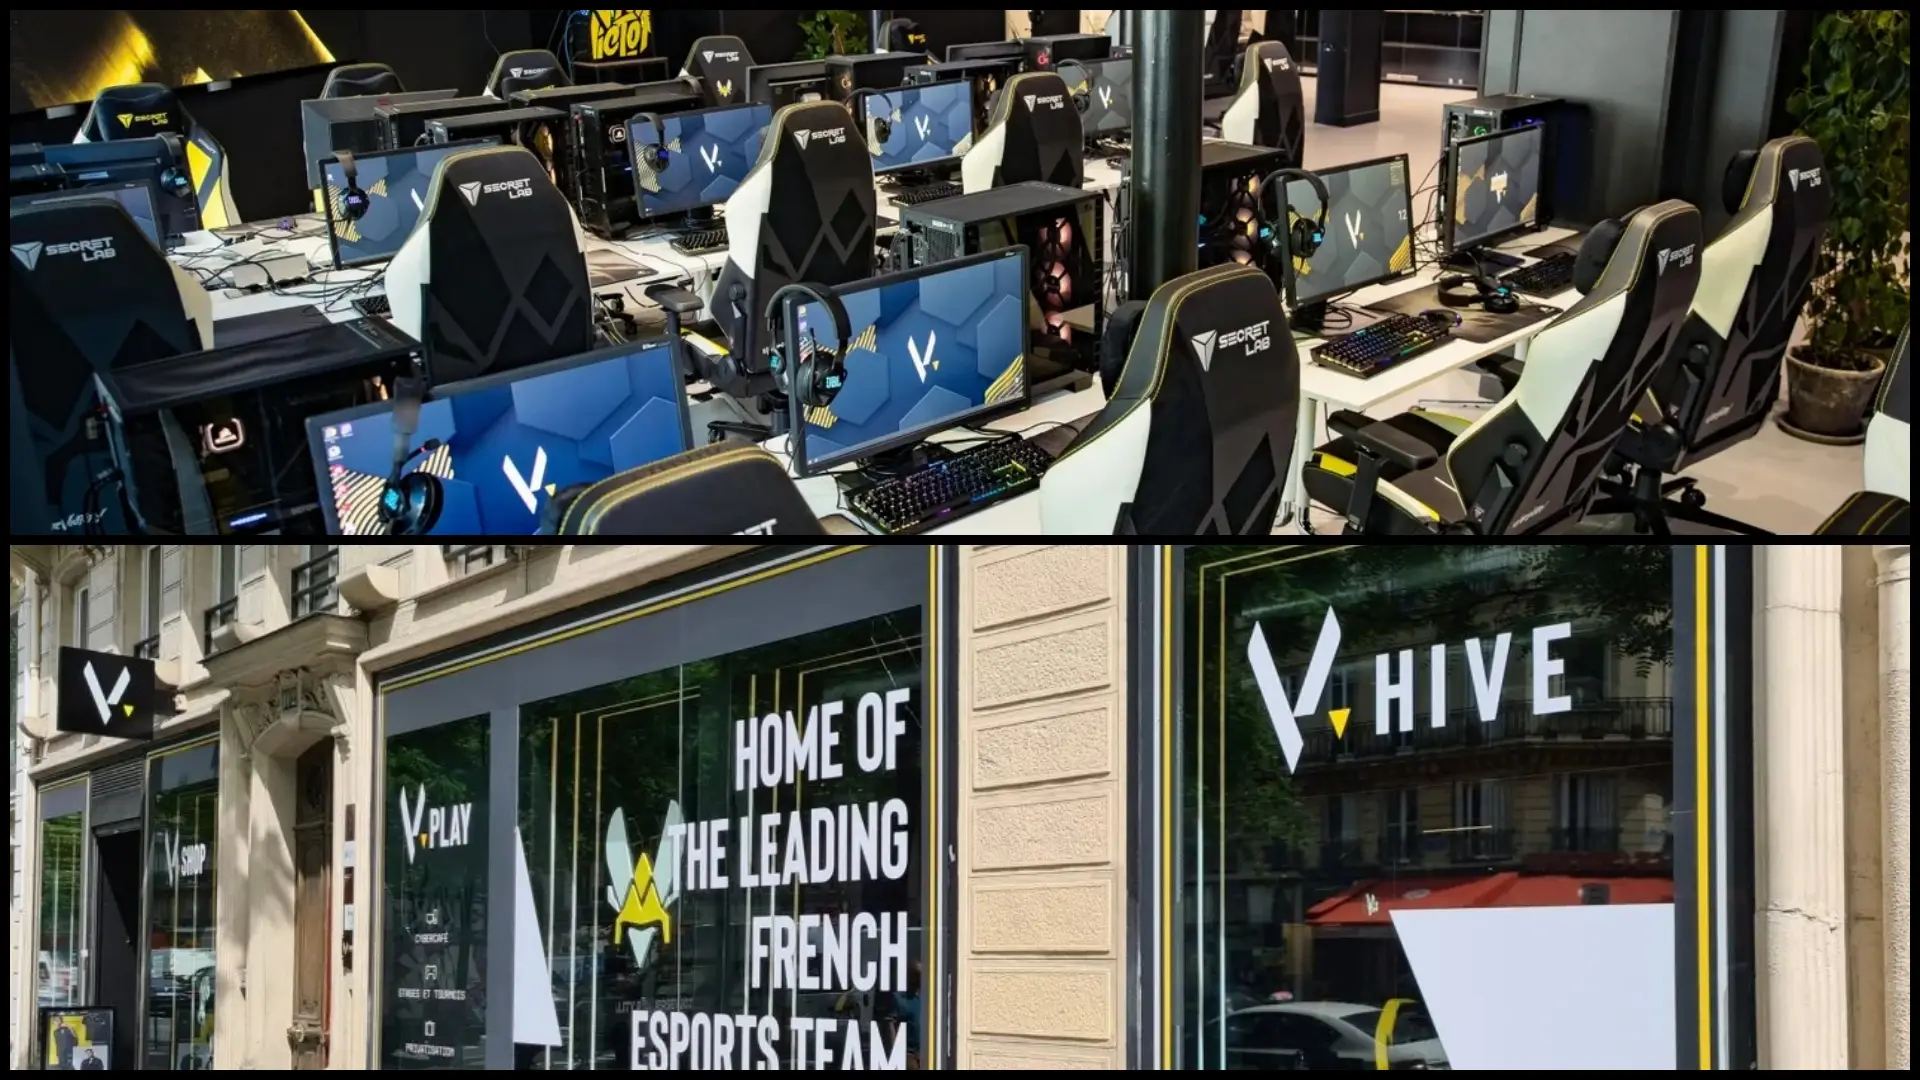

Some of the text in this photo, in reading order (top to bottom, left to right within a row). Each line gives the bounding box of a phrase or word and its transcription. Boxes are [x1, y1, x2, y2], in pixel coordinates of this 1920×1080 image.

[482, 177, 531, 194] SECRET
[508, 187, 533, 199] LAB
[45, 236, 114, 256] SECRET
[81, 248, 116, 262] LAB
[1218, 320, 1270, 350] SECRET
[1245, 336, 1271, 357] LAB
[1376, 622, 1572, 735] HIVE
[735, 687, 910, 792] HOME OF
[429, 802, 472, 850] PLAY
[668, 798, 908, 892] THE LEADING
[751, 911, 908, 993] FRENCH
[630, 1009, 907, 1070] ESPORTS TEAM
